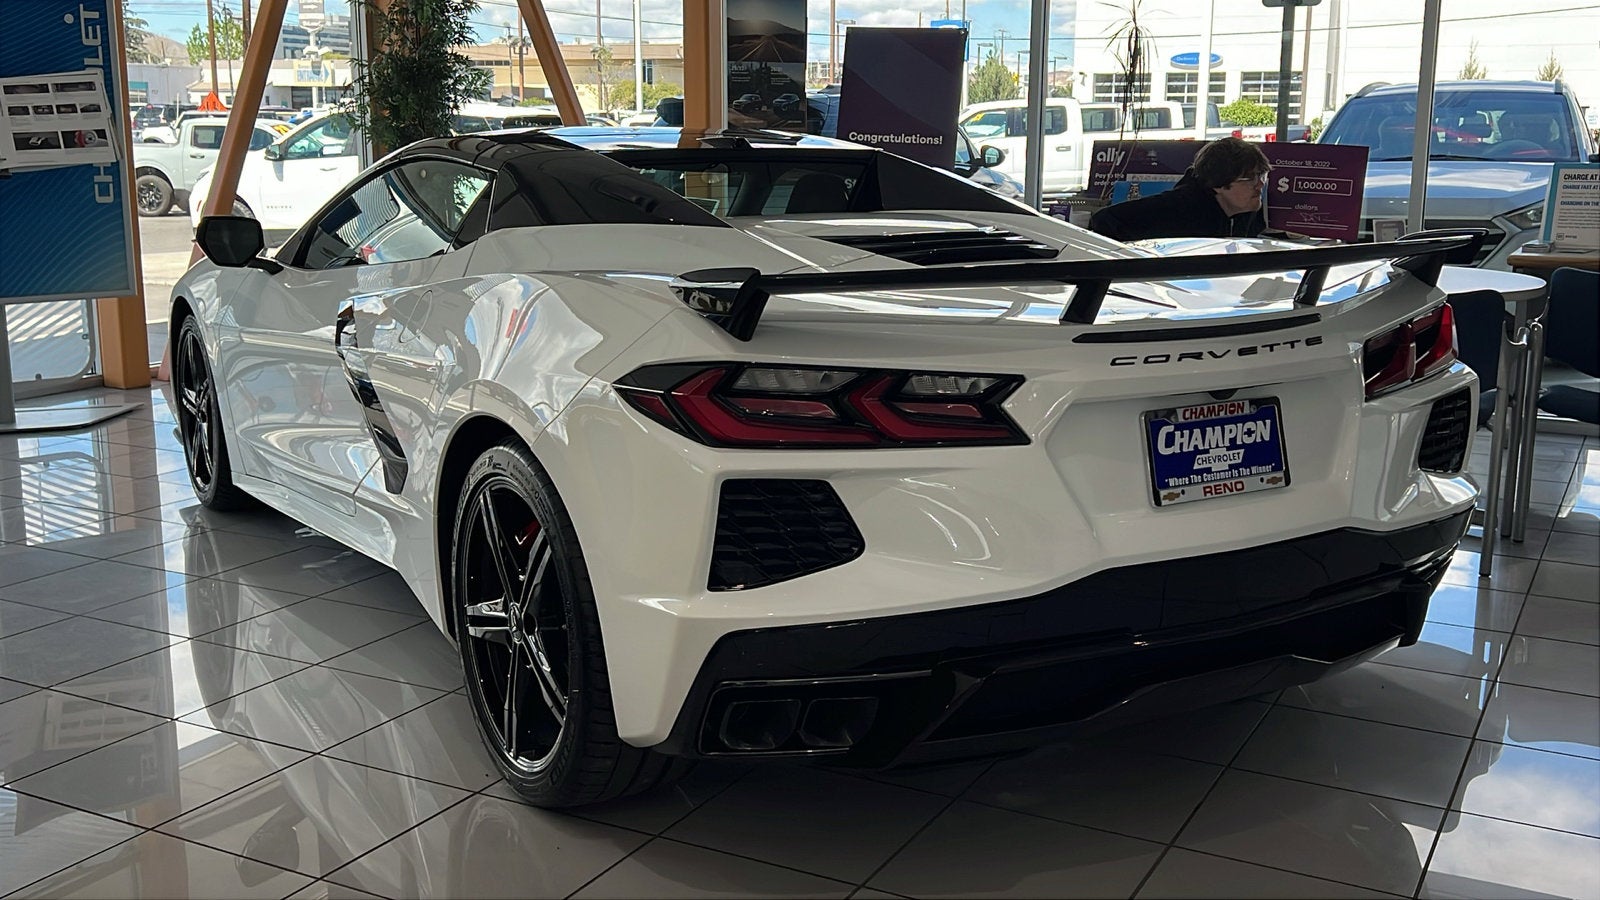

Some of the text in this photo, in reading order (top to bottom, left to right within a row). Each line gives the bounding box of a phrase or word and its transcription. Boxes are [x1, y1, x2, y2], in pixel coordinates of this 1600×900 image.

[848, 131, 943, 145] Congratulations!
[1096, 147, 1126, 166] ally
[1277, 176, 1337, 194] $ 1,000.00
[1110, 335, 1323, 367] CORVETTE
[1182, 402, 1245, 421] CHAMPION
[1157, 420, 1271, 455] CHAMPION
[1196, 451, 1242, 466] CHEVROLET
[1190, 474, 1202, 484] The
[1203, 471, 1232, 482] Customer
[1232, 469, 1239, 478] Is
[1239, 467, 1251, 477] The
[1203, 480, 1245, 497] RENO
